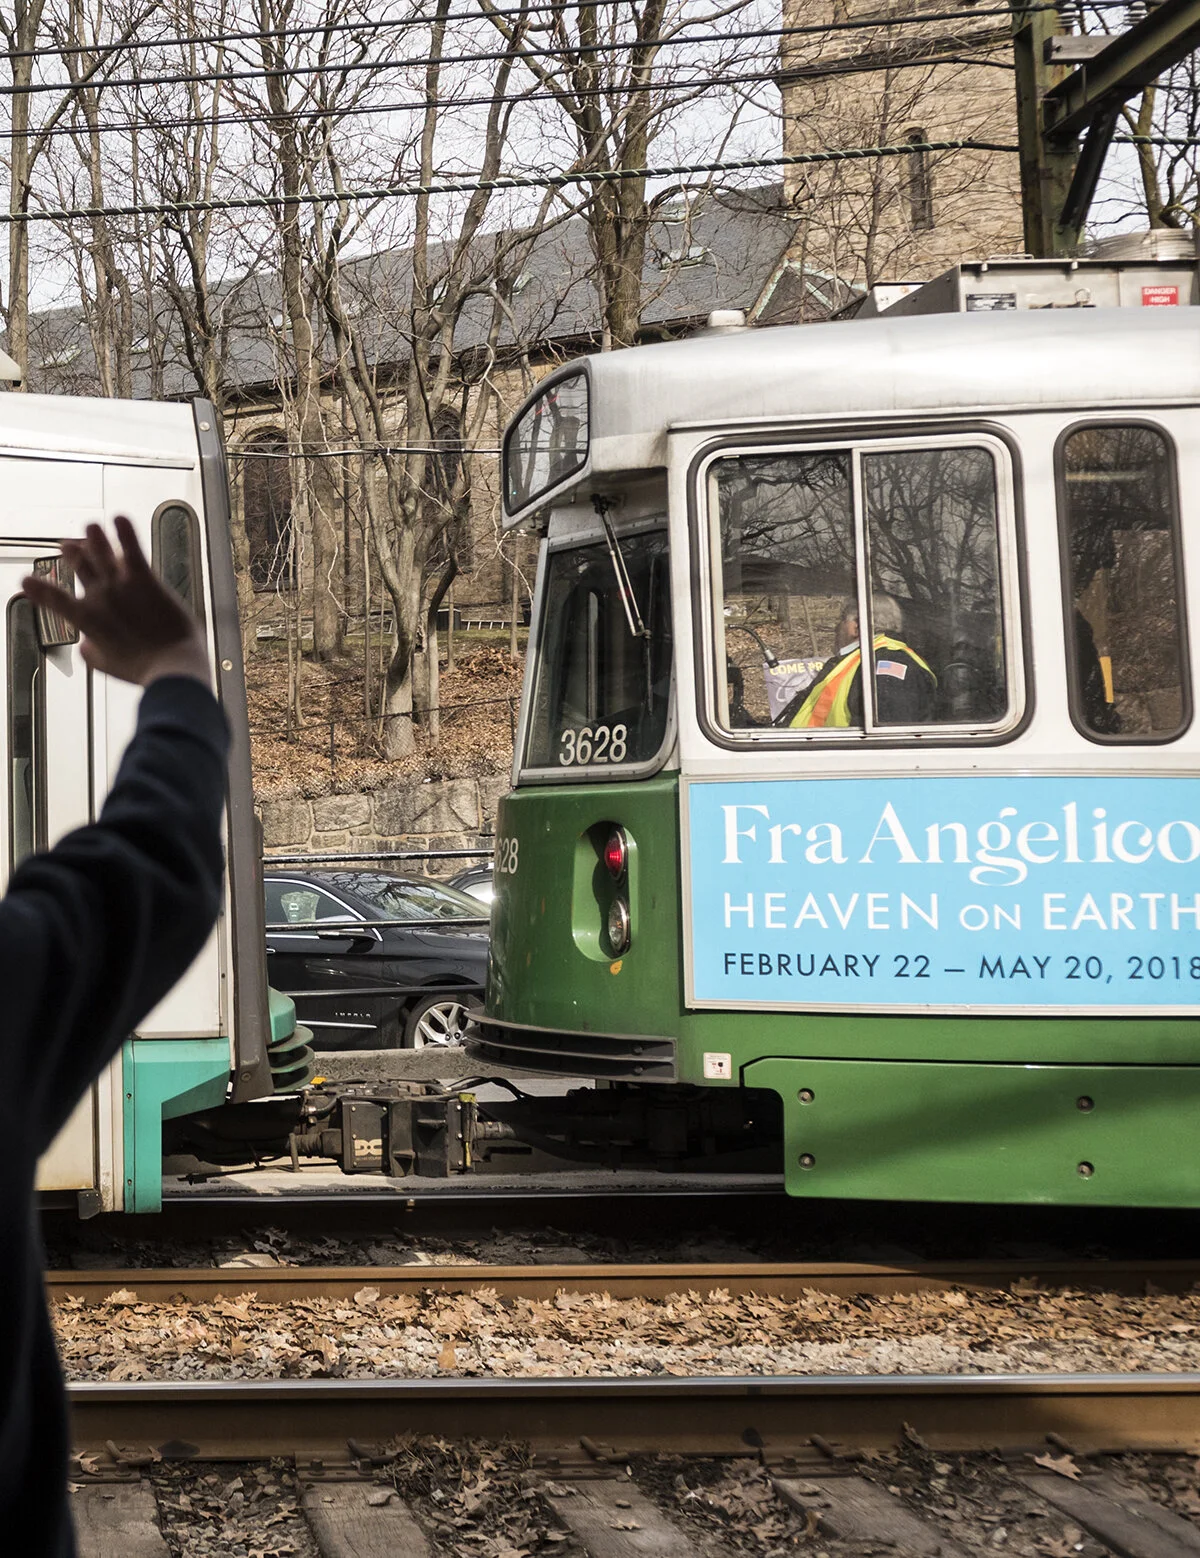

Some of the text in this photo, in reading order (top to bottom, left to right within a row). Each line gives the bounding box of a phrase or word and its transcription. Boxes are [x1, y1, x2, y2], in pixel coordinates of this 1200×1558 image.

[769, 662, 805, 676] COME
[559, 724, 628, 766] 3628
[720, 800, 1200, 886] Fra Angelico
[723, 892, 1200, 931] HEAVEN ON EARTH
[723, 953, 881, 977] FEBRUARY
[893, 954, 931, 978] 22
[978, 955, 1052, 979] MAY
[1064, 956, 1113, 985] 20,
[1127, 956, 1200, 980] 2018
